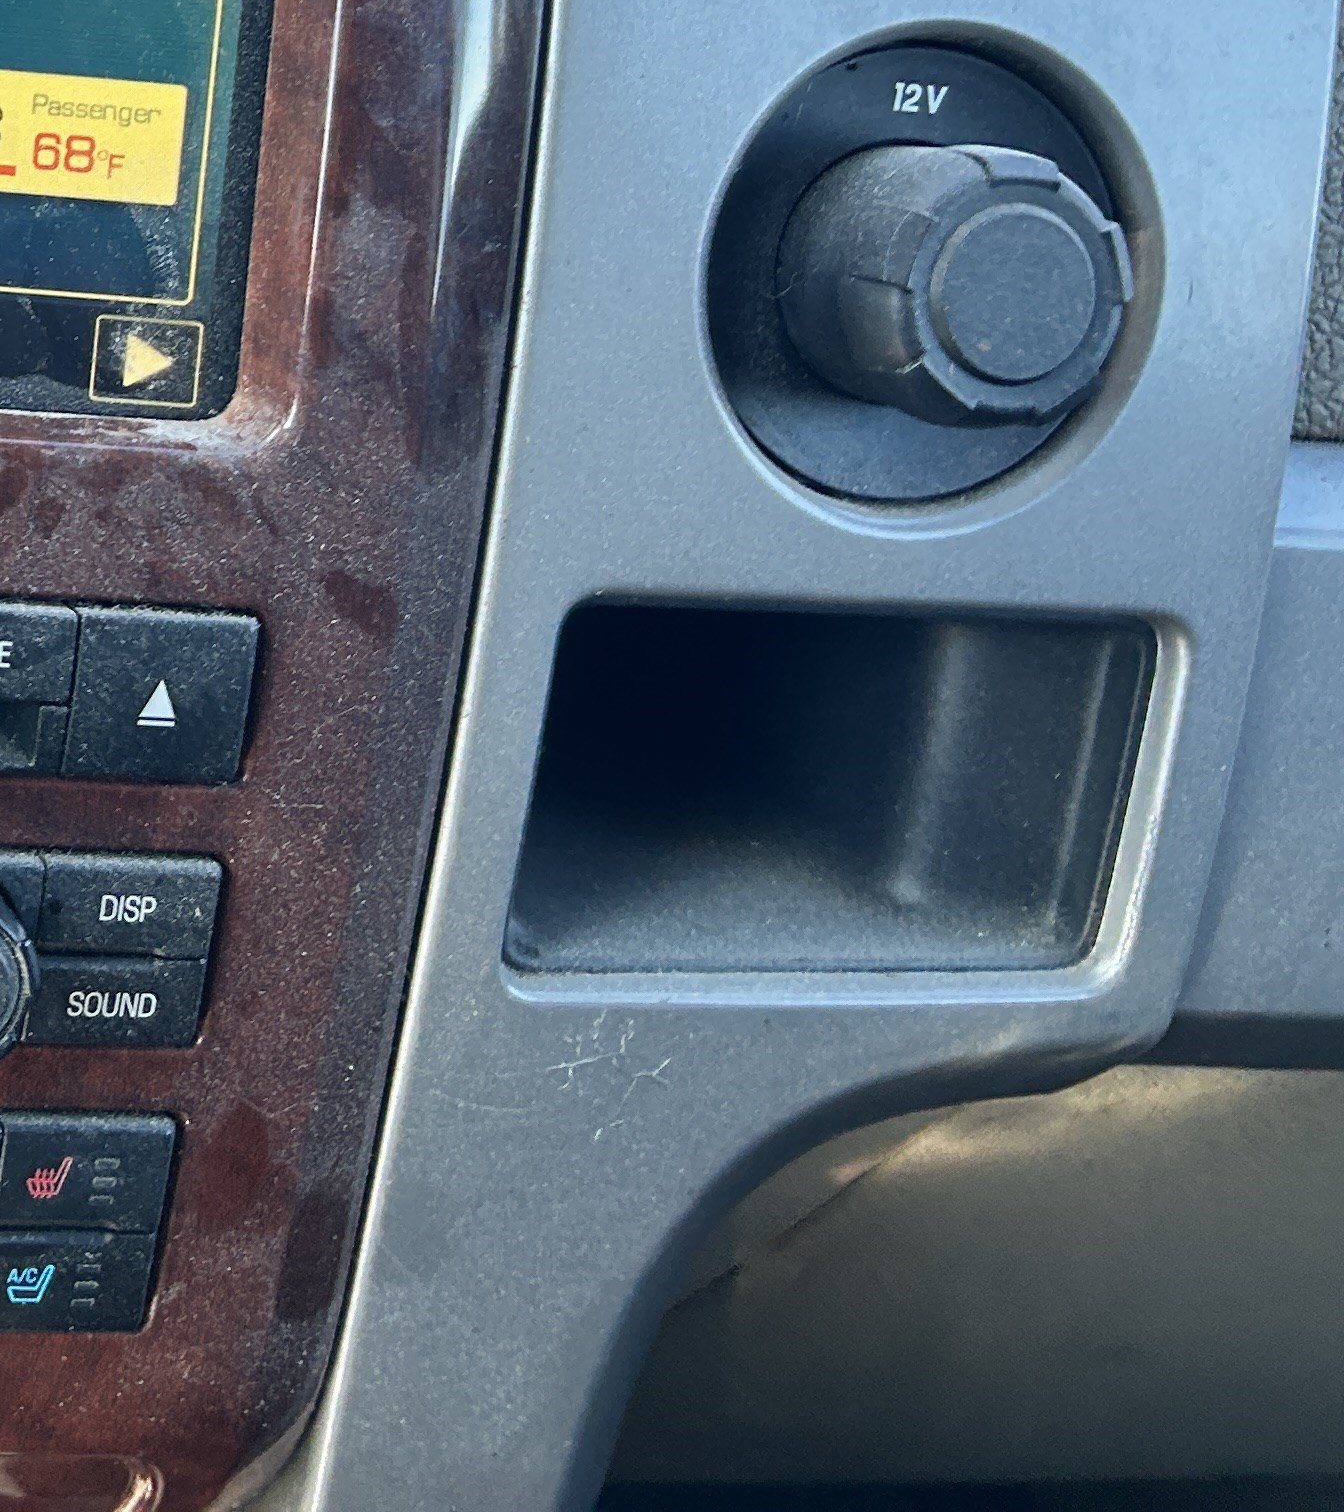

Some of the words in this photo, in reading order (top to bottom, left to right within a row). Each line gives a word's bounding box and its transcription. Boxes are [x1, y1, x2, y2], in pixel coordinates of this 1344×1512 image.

[31, 93, 162, 125] Passenger
[892, 82, 949, 114] 12V
[98, 895, 157, 923] DISP
[67, 991, 157, 1018] SOUND
[6, 1267, 39, 1285] A/C
